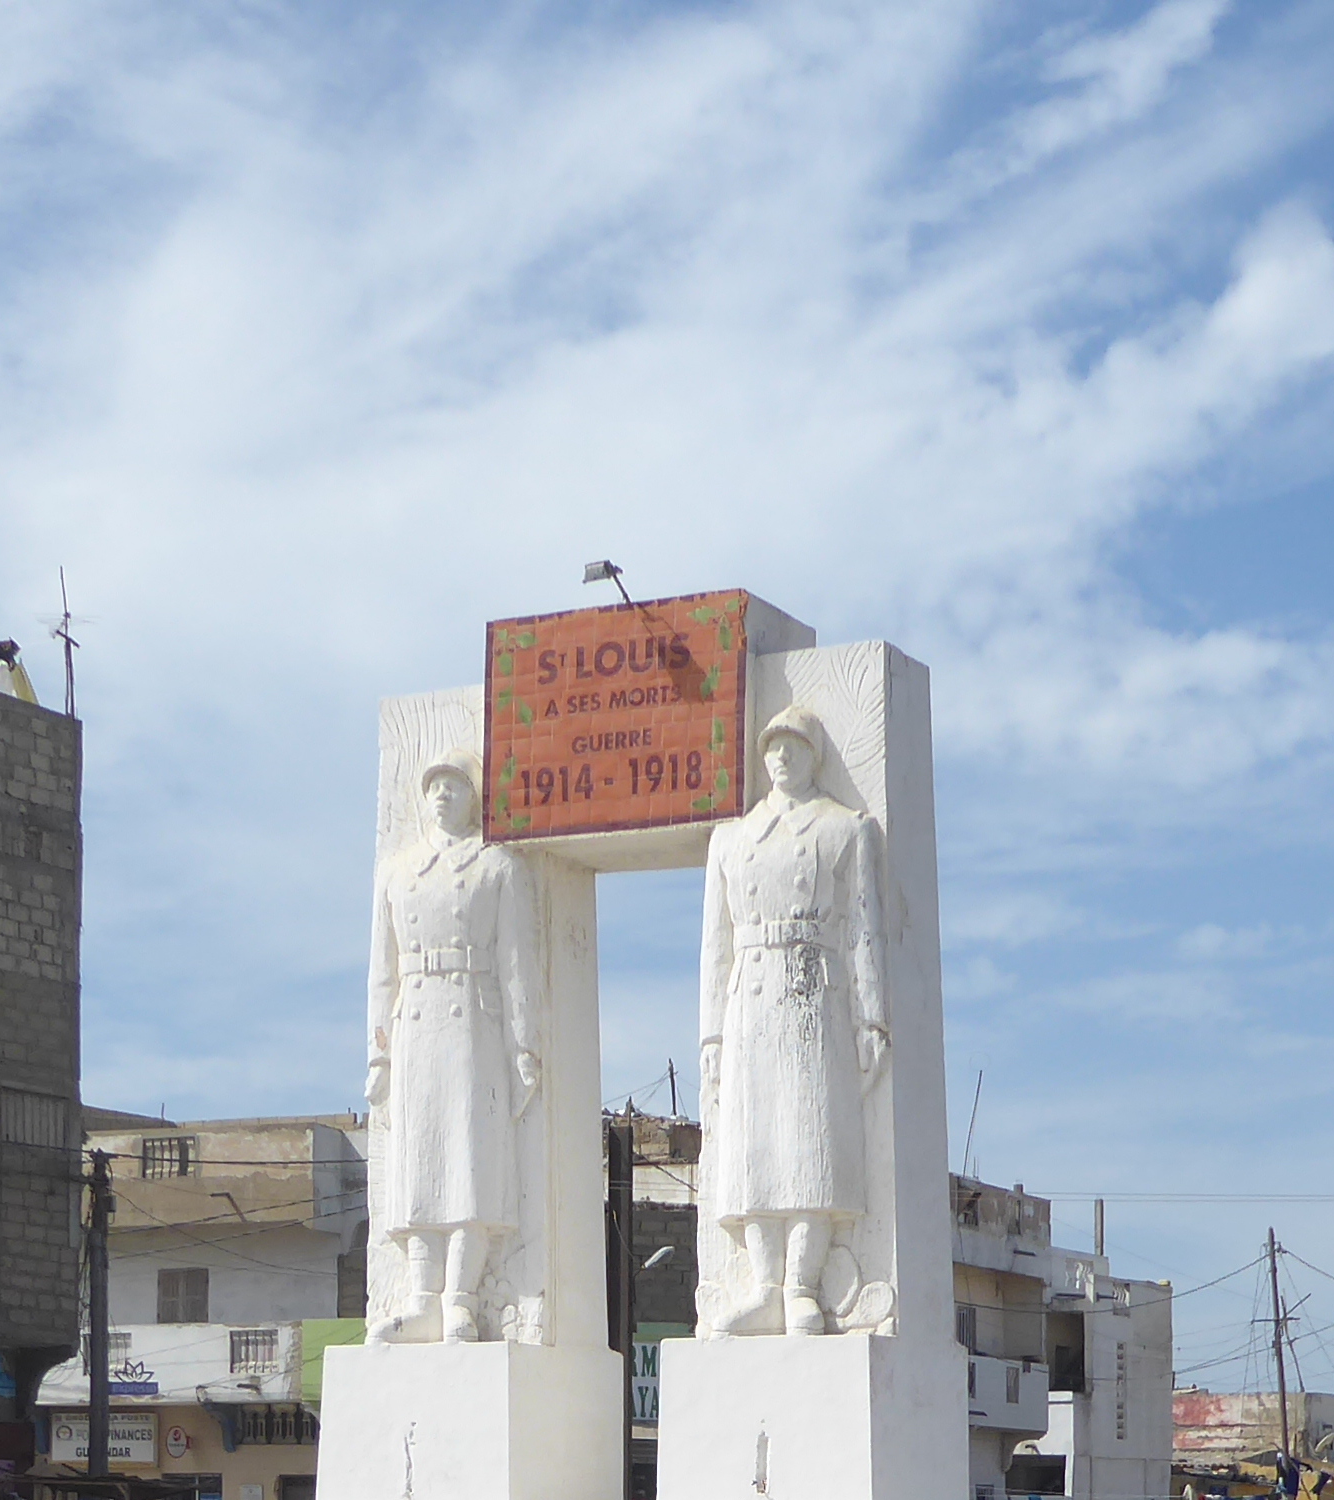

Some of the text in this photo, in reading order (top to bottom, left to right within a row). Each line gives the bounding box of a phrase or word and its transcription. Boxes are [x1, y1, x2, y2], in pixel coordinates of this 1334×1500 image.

[576, 632, 691, 679] LOUIS
[544, 685, 682, 717] A SES MORTS
[571, 728, 652, 755] GUERRE
[521, 763, 594, 807] 1914
[629, 751, 702, 795] 1918
